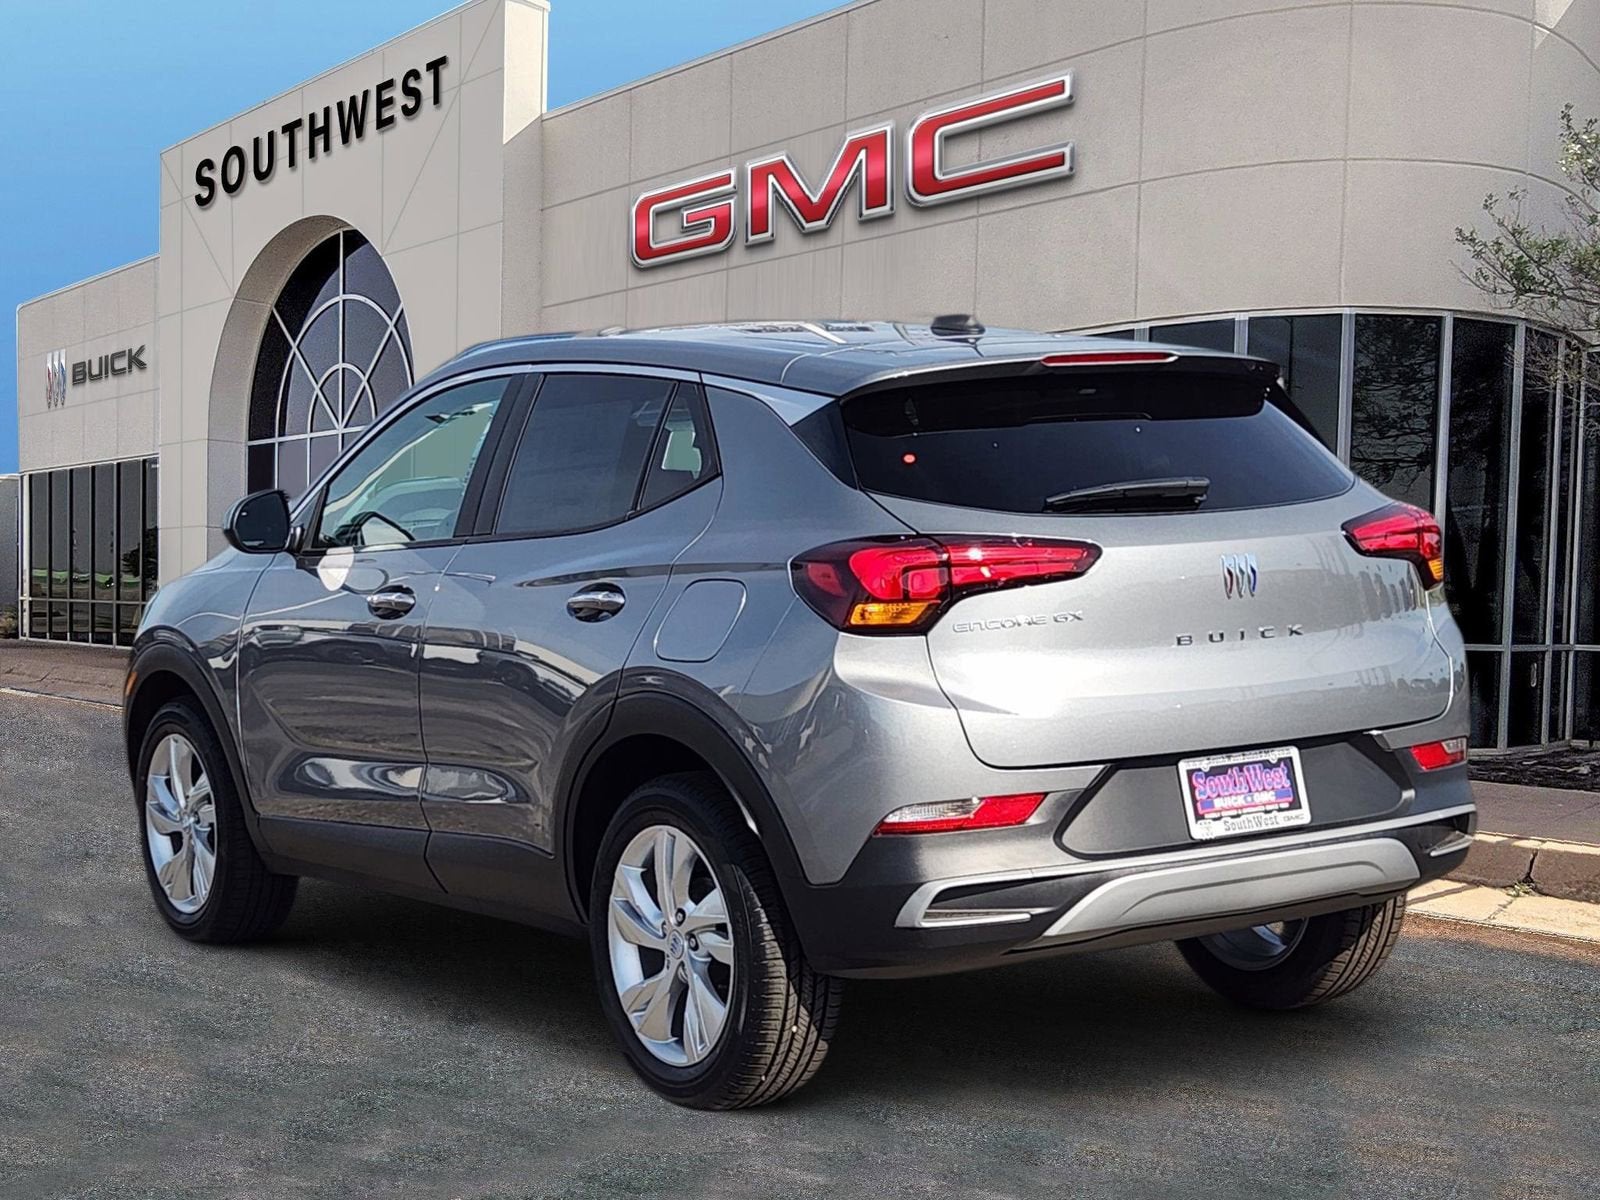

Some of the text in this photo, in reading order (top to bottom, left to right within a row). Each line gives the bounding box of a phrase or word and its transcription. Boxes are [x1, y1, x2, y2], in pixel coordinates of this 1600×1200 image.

[194, 56, 448, 207] SOUTHWEST
[630, 68, 1076, 269] GMC
[72, 344, 147, 386] BUICK
[1053, 610, 1084, 623] GX
[1176, 624, 1304, 647] BUICK
[1192, 762, 1291, 798] SouthWest
[1223, 814, 1280, 832] SouthWest
